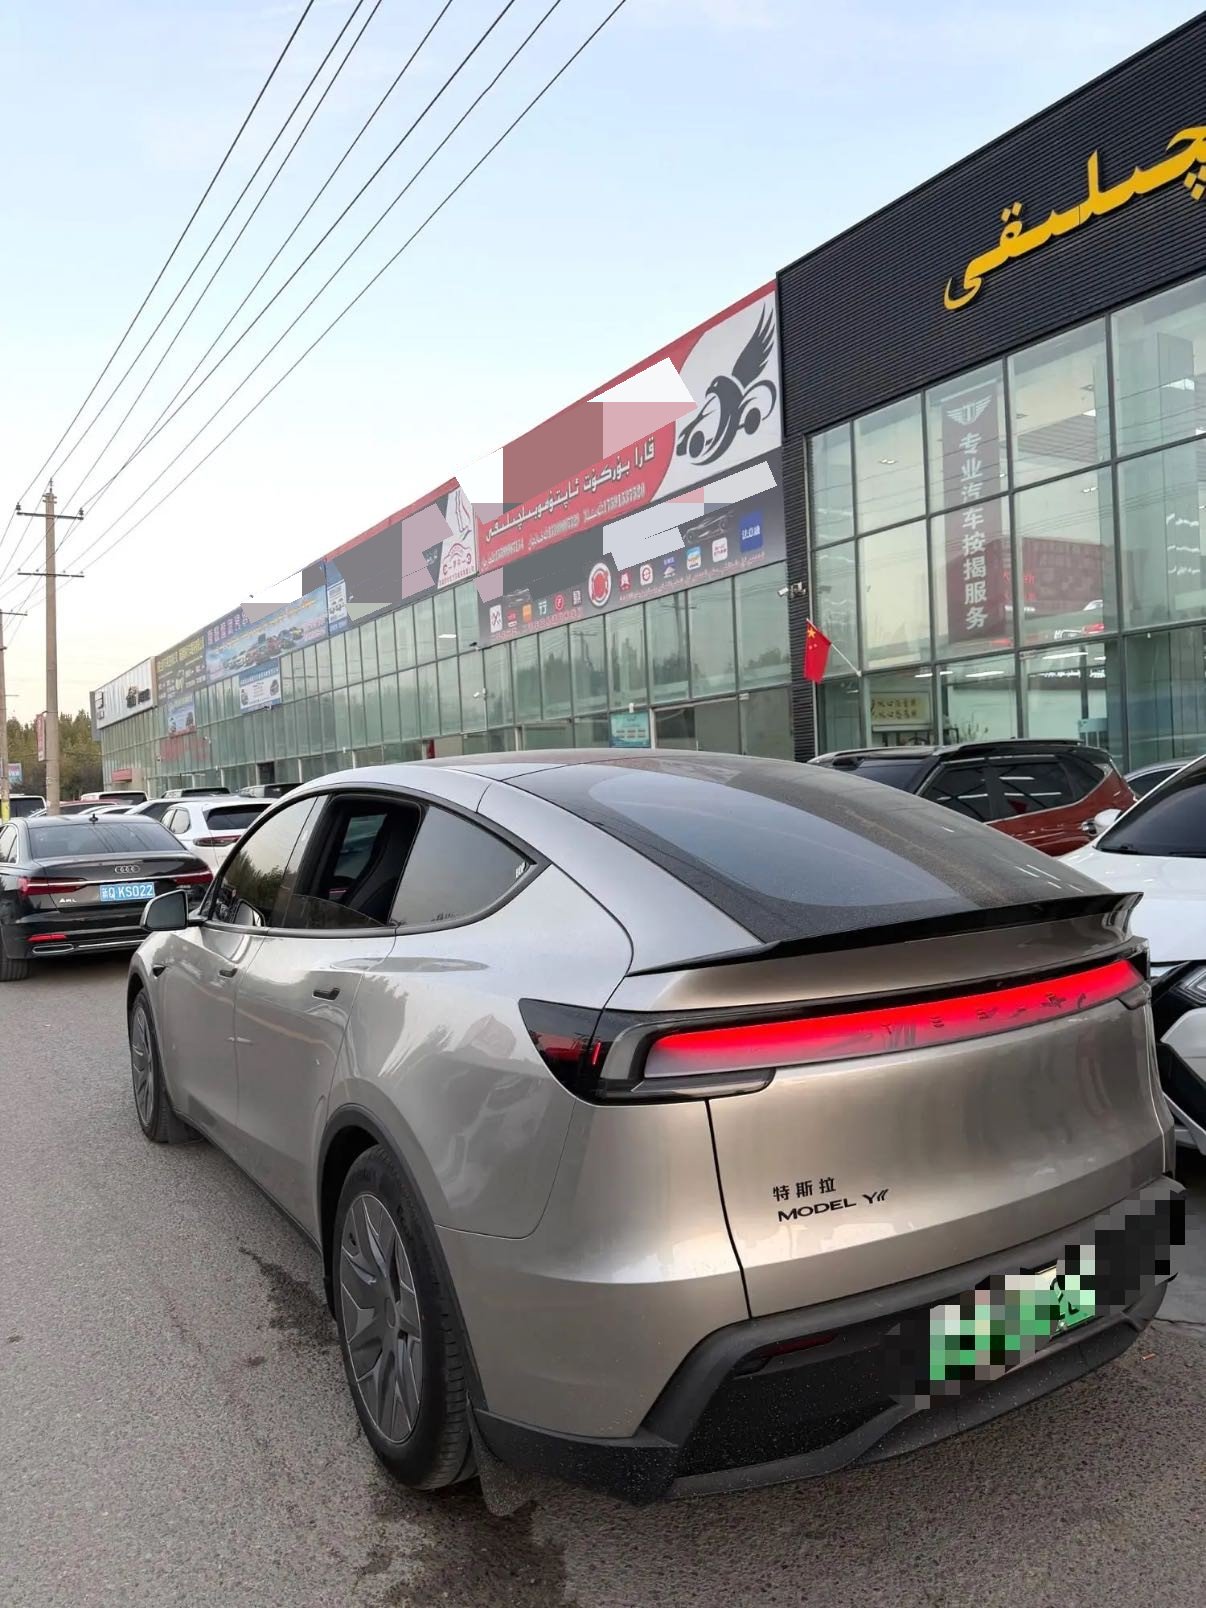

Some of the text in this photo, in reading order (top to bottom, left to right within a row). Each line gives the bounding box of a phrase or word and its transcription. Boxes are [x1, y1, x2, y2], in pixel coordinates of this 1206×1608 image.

[635, 436, 655, 467] قارا
[958, 432, 989, 631] 专业汽车按揭服务
[772, 1177, 837, 1202] 特斯拉
[777, 1198, 857, 1222] MODEL
